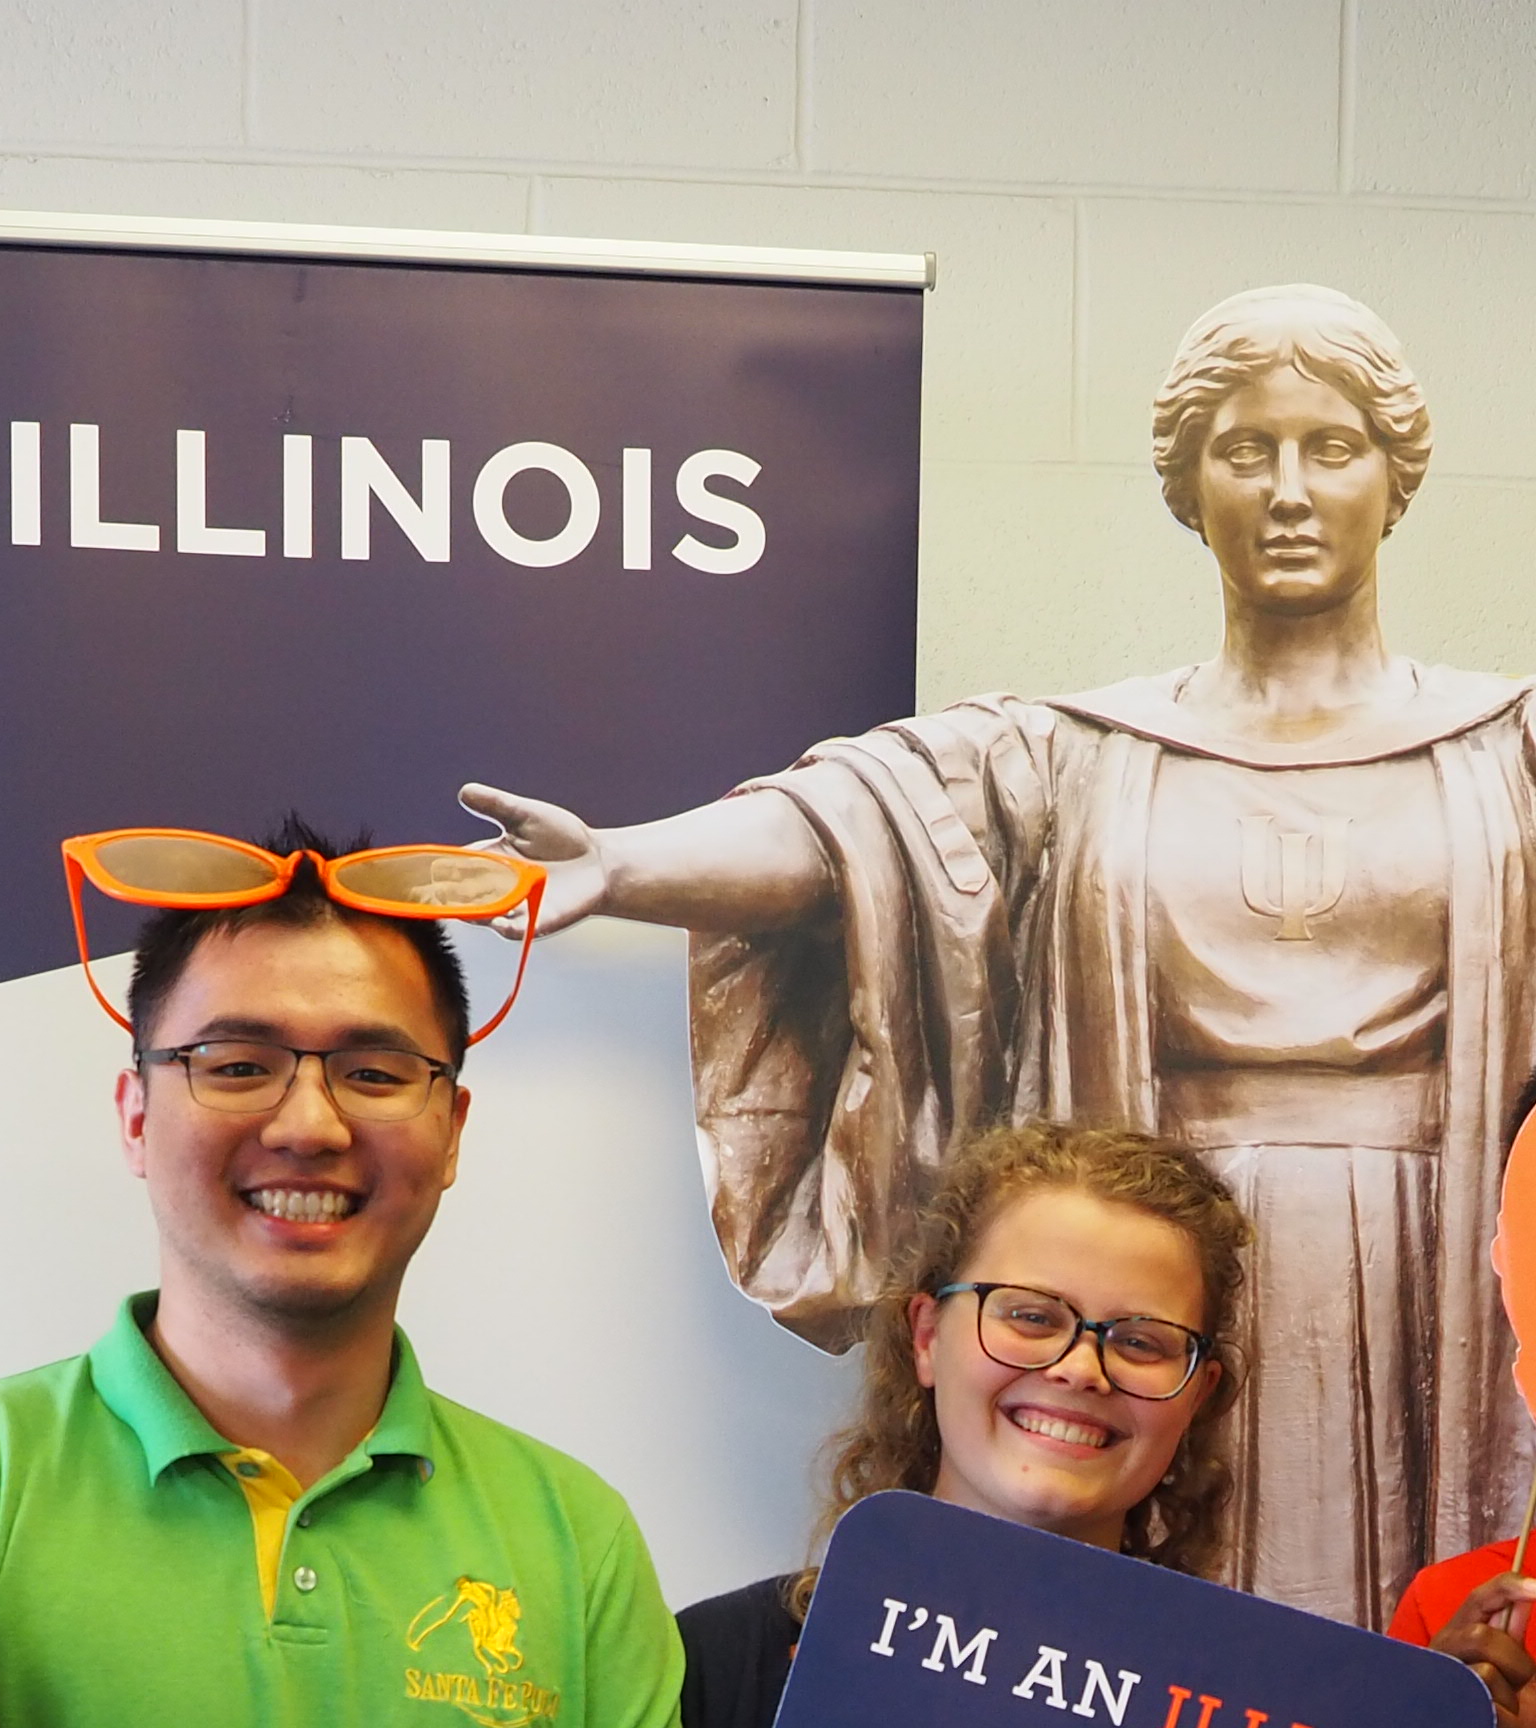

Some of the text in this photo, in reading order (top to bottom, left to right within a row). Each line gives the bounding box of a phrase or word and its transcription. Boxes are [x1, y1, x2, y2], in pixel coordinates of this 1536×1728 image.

[11, 421, 766, 575] ILLINOIS
[405, 1668, 481, 1706] SANTA
[487, 1676, 518, 1710] FE
[869, 1597, 999, 1685] I'M
[1011, 1644, 1141, 1727] AN
